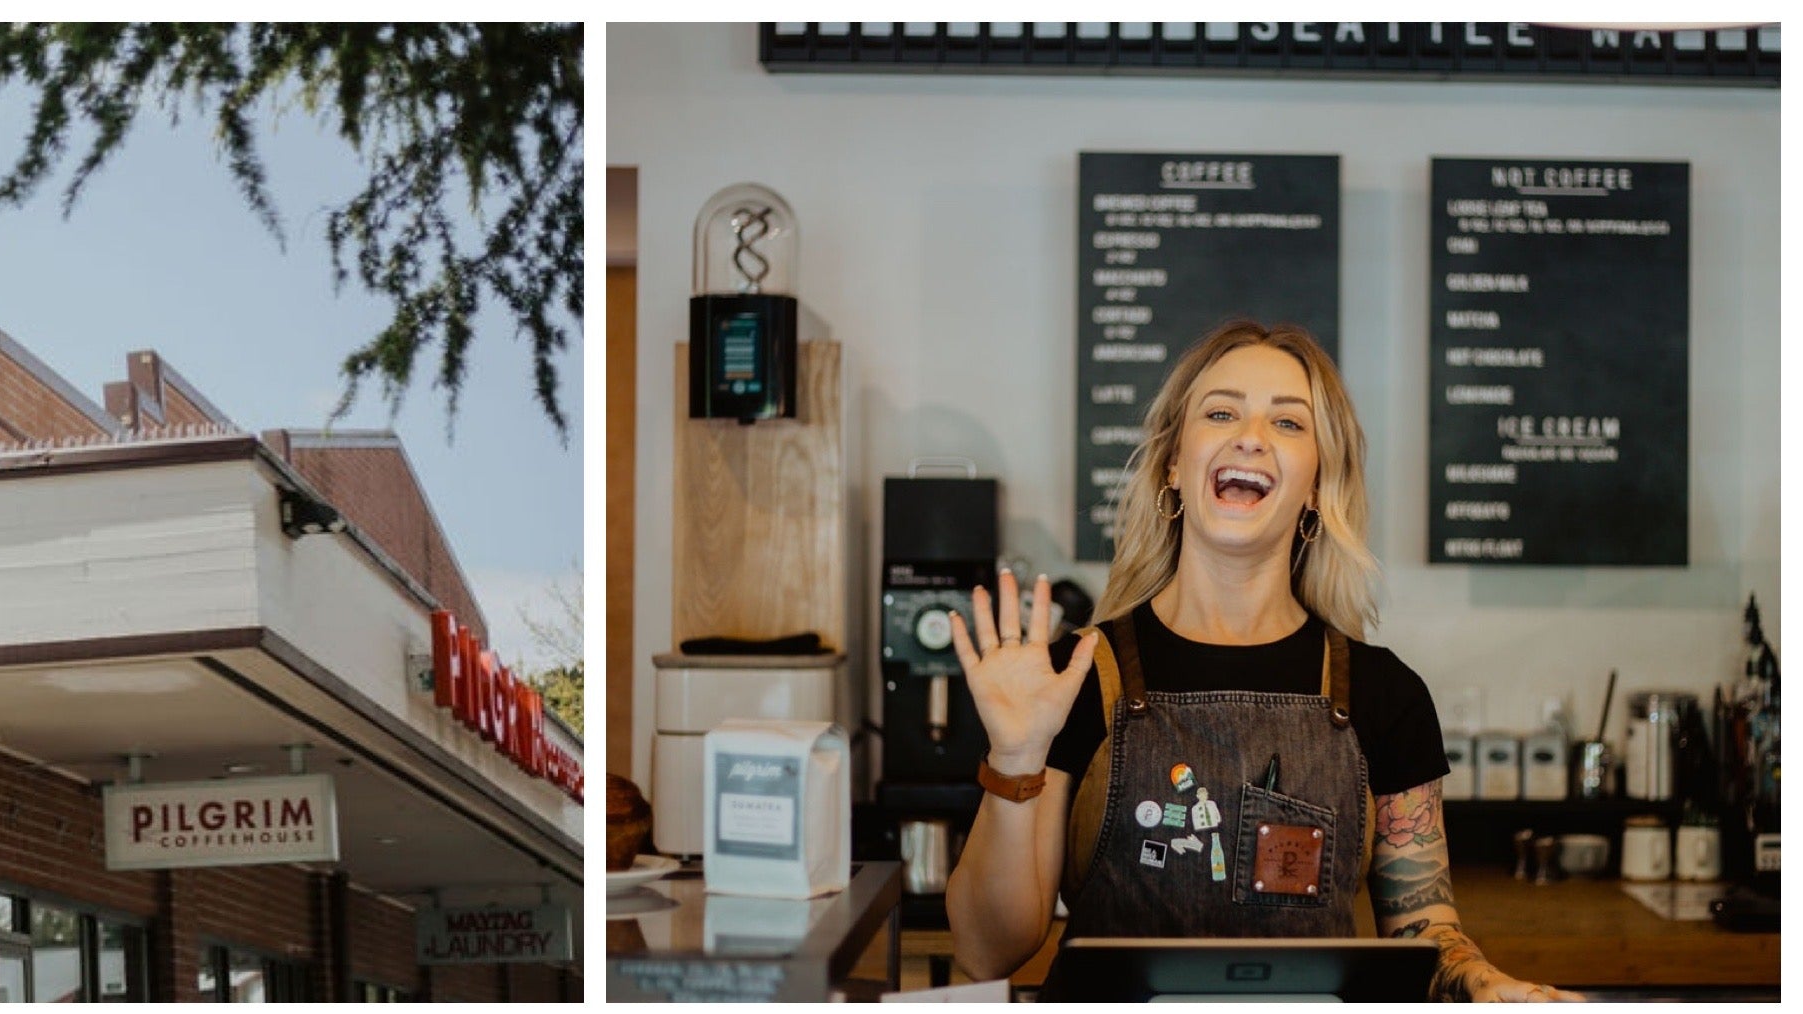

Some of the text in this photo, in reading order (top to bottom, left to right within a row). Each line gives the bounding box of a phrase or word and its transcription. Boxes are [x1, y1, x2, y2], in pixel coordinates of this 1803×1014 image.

[1161, 161, 1253, 182] COFFEE
[1491, 167, 1633, 190] NOT COFFEE
[1498, 416, 1620, 440] ICE CREAM
[132, 797, 313, 843] PILGRIM
[160, 830, 315, 848] COFFEEHOUSE
[447, 911, 533, 932] MAYTAG
[429, 931, 552, 959] LAUNDRY
